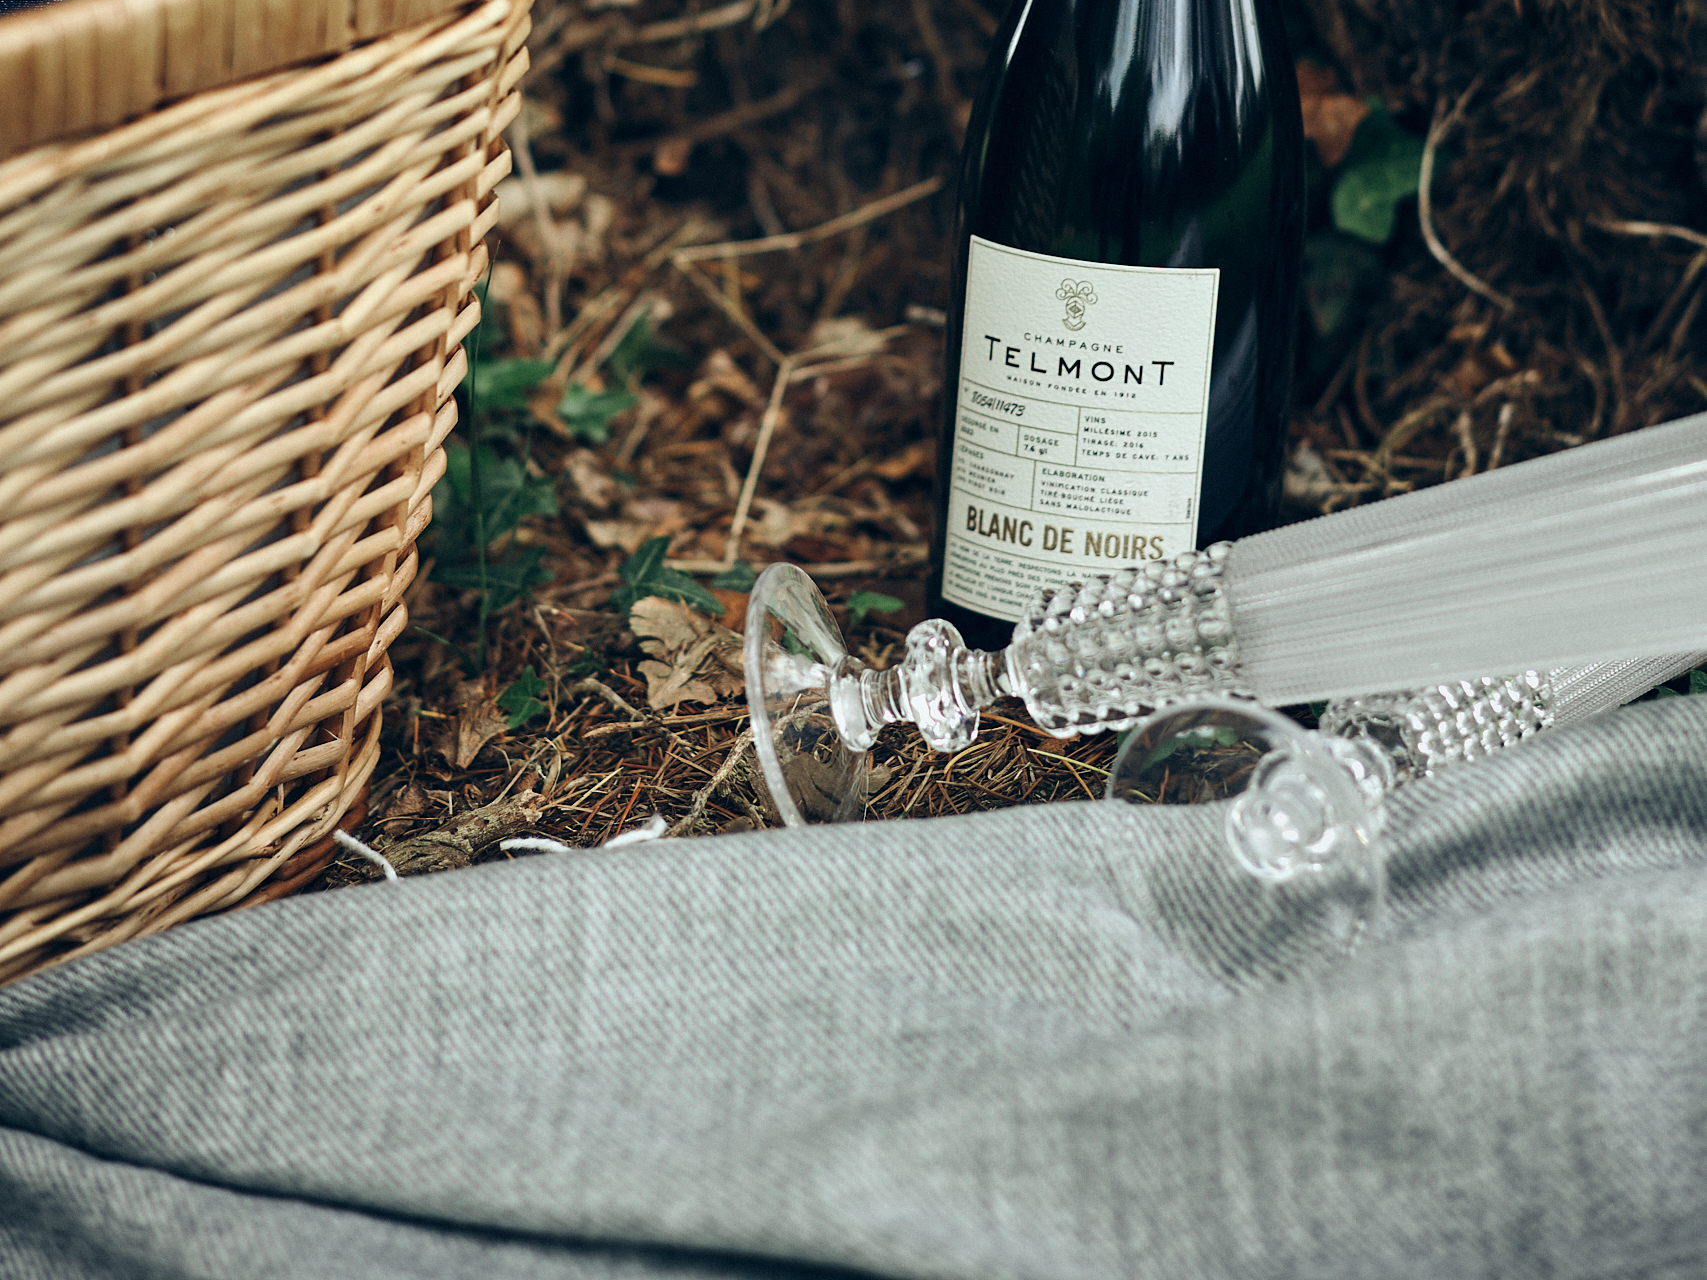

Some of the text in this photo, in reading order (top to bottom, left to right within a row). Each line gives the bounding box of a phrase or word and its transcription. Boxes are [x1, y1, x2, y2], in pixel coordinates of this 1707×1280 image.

[1023, 332, 1123, 353] CHAMPAGNE
[984, 334, 1175, 386] TELMONT
[1007, 375, 1041, 387] MAISON
[1048, 383, 1087, 395] FONDÉE
[1114, 391, 1136, 399] 1912
[1084, 415, 1106, 424] VINS
[1083, 426, 1131, 437] MILLÉSIME
[1023, 434, 1060, 446] DOSAGE
[1123, 441, 1144, 449] 2016
[1082, 449, 1110, 458] TEMPS
[1041, 480, 1149, 497] VINIFICATION CLASSIQUE
[1039, 499, 1131, 515] SANS MALOLACTIQUE
[966, 505, 1165, 560] BLANC DE NOIRS
[1018, 562, 1062, 575] RESPECTONS
